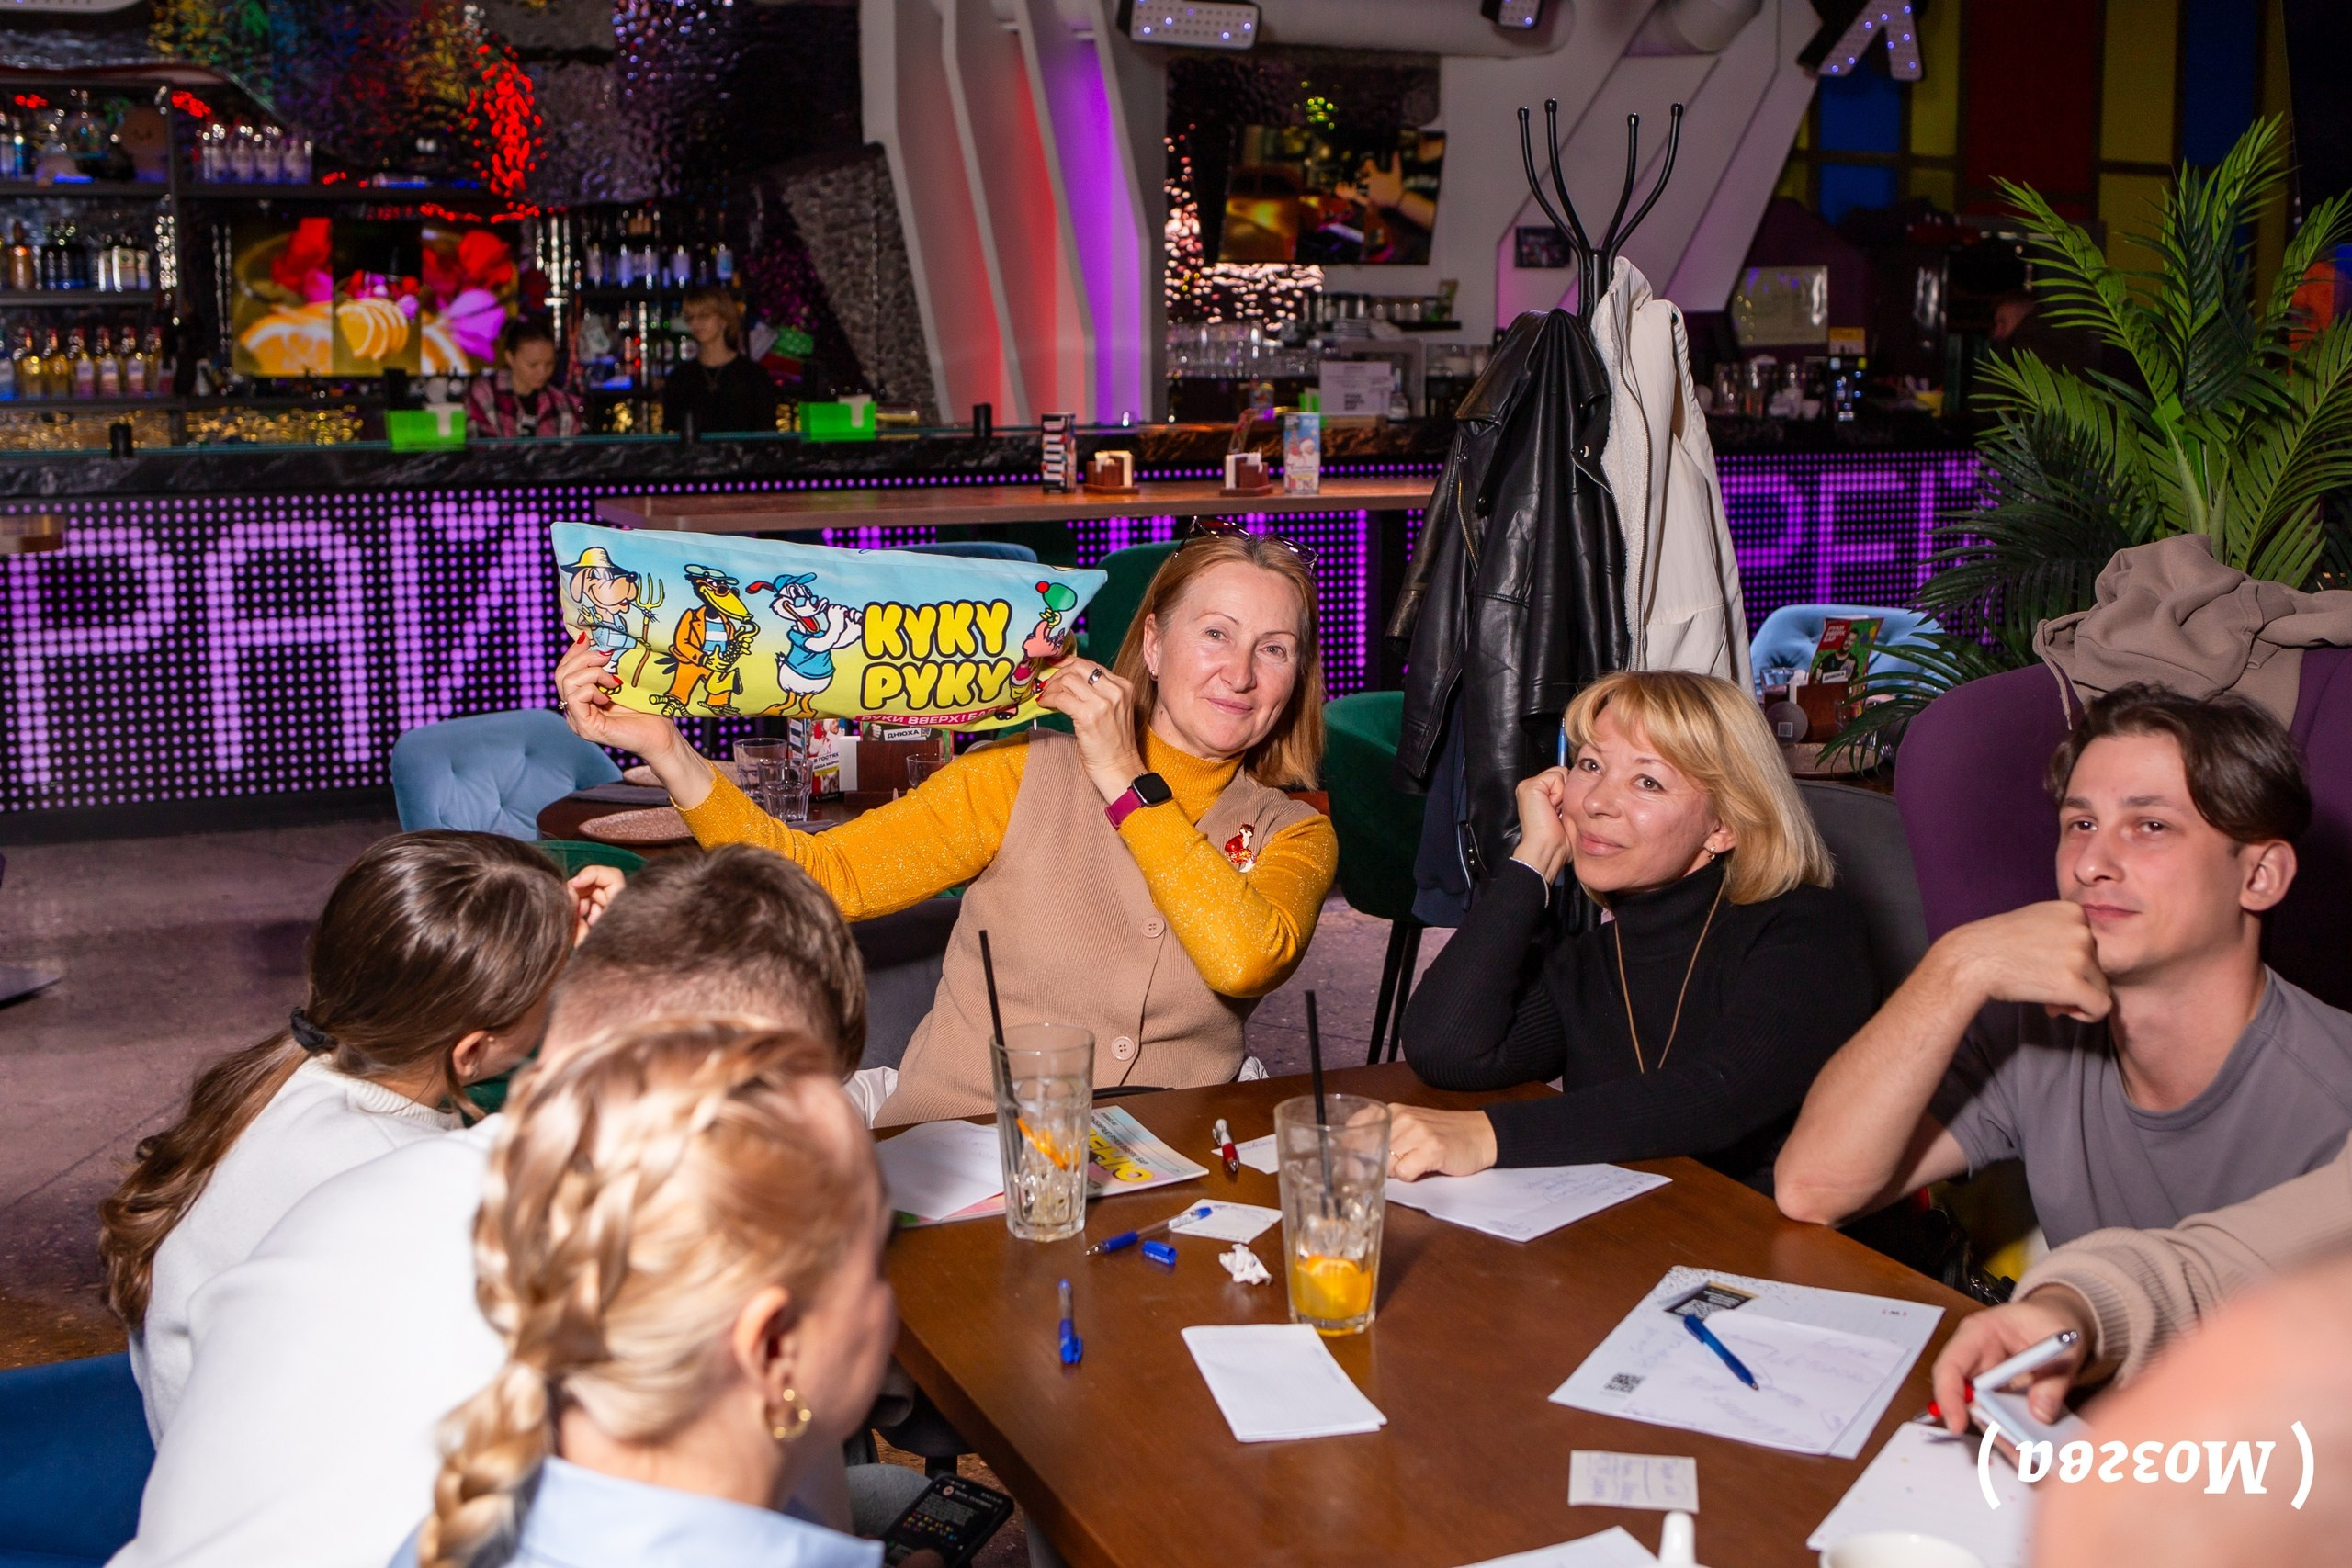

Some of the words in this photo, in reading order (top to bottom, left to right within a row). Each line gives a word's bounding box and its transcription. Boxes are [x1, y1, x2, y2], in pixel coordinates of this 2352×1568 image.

[863, 599, 1012, 661] КУКУ
[860, 657, 1015, 710] РУКУ
[862, 715, 905, 723] РУКИ
[887, 728, 921, 739] ДНЮХА
[1089, 1127, 1155, 1183] ЕНЮ
